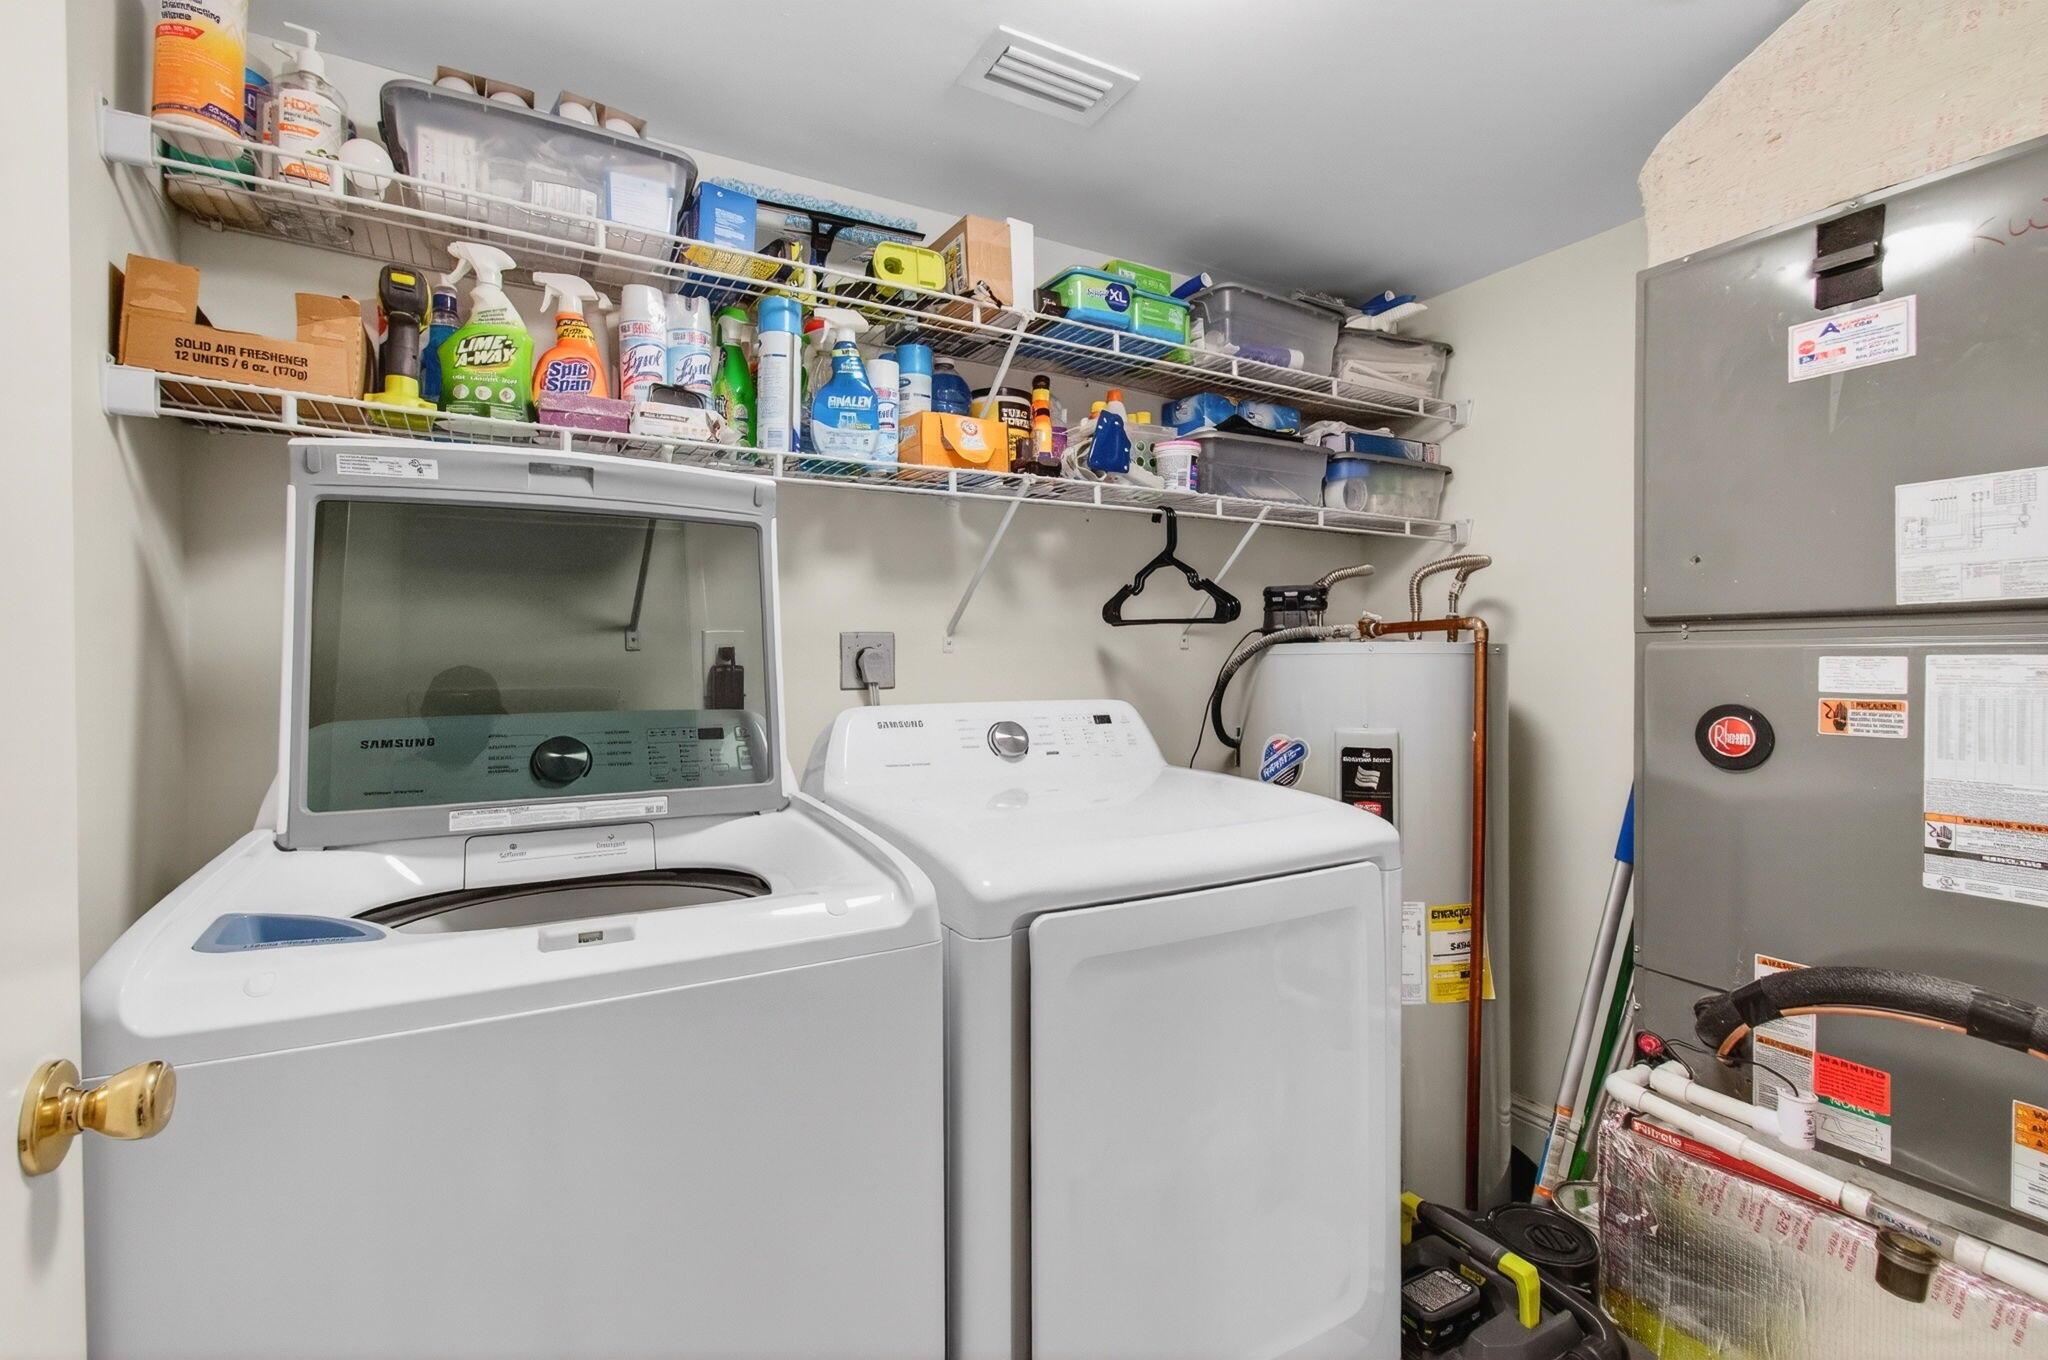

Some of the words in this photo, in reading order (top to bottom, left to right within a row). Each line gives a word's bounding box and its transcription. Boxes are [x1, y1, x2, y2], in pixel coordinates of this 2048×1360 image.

[1109, 288, 1128, 304] XL
[175, 337, 212, 352] SOLID
[215, 344, 236, 356] AIR
[239, 347, 309, 368] FRESHENER
[175, 350, 190, 361] 12
[192, 351, 230, 367] UNITS
[231, 358, 238, 369] /
[252, 363, 270, 374] oz.
[454, 347, 517, 368] A-WAY
[622, 349, 662, 376] Lysol
[548, 361, 589, 380] Spic
[546, 378, 592, 393] Span
[877, 719, 924, 729] SAMSUNG
[1714, 719, 1751, 750] Rheem
[360, 738, 436, 750] SAMSUNG
[1818, 1054, 1887, 1080] WARNING
[1632, 1120, 1683, 1147] Filtrete
